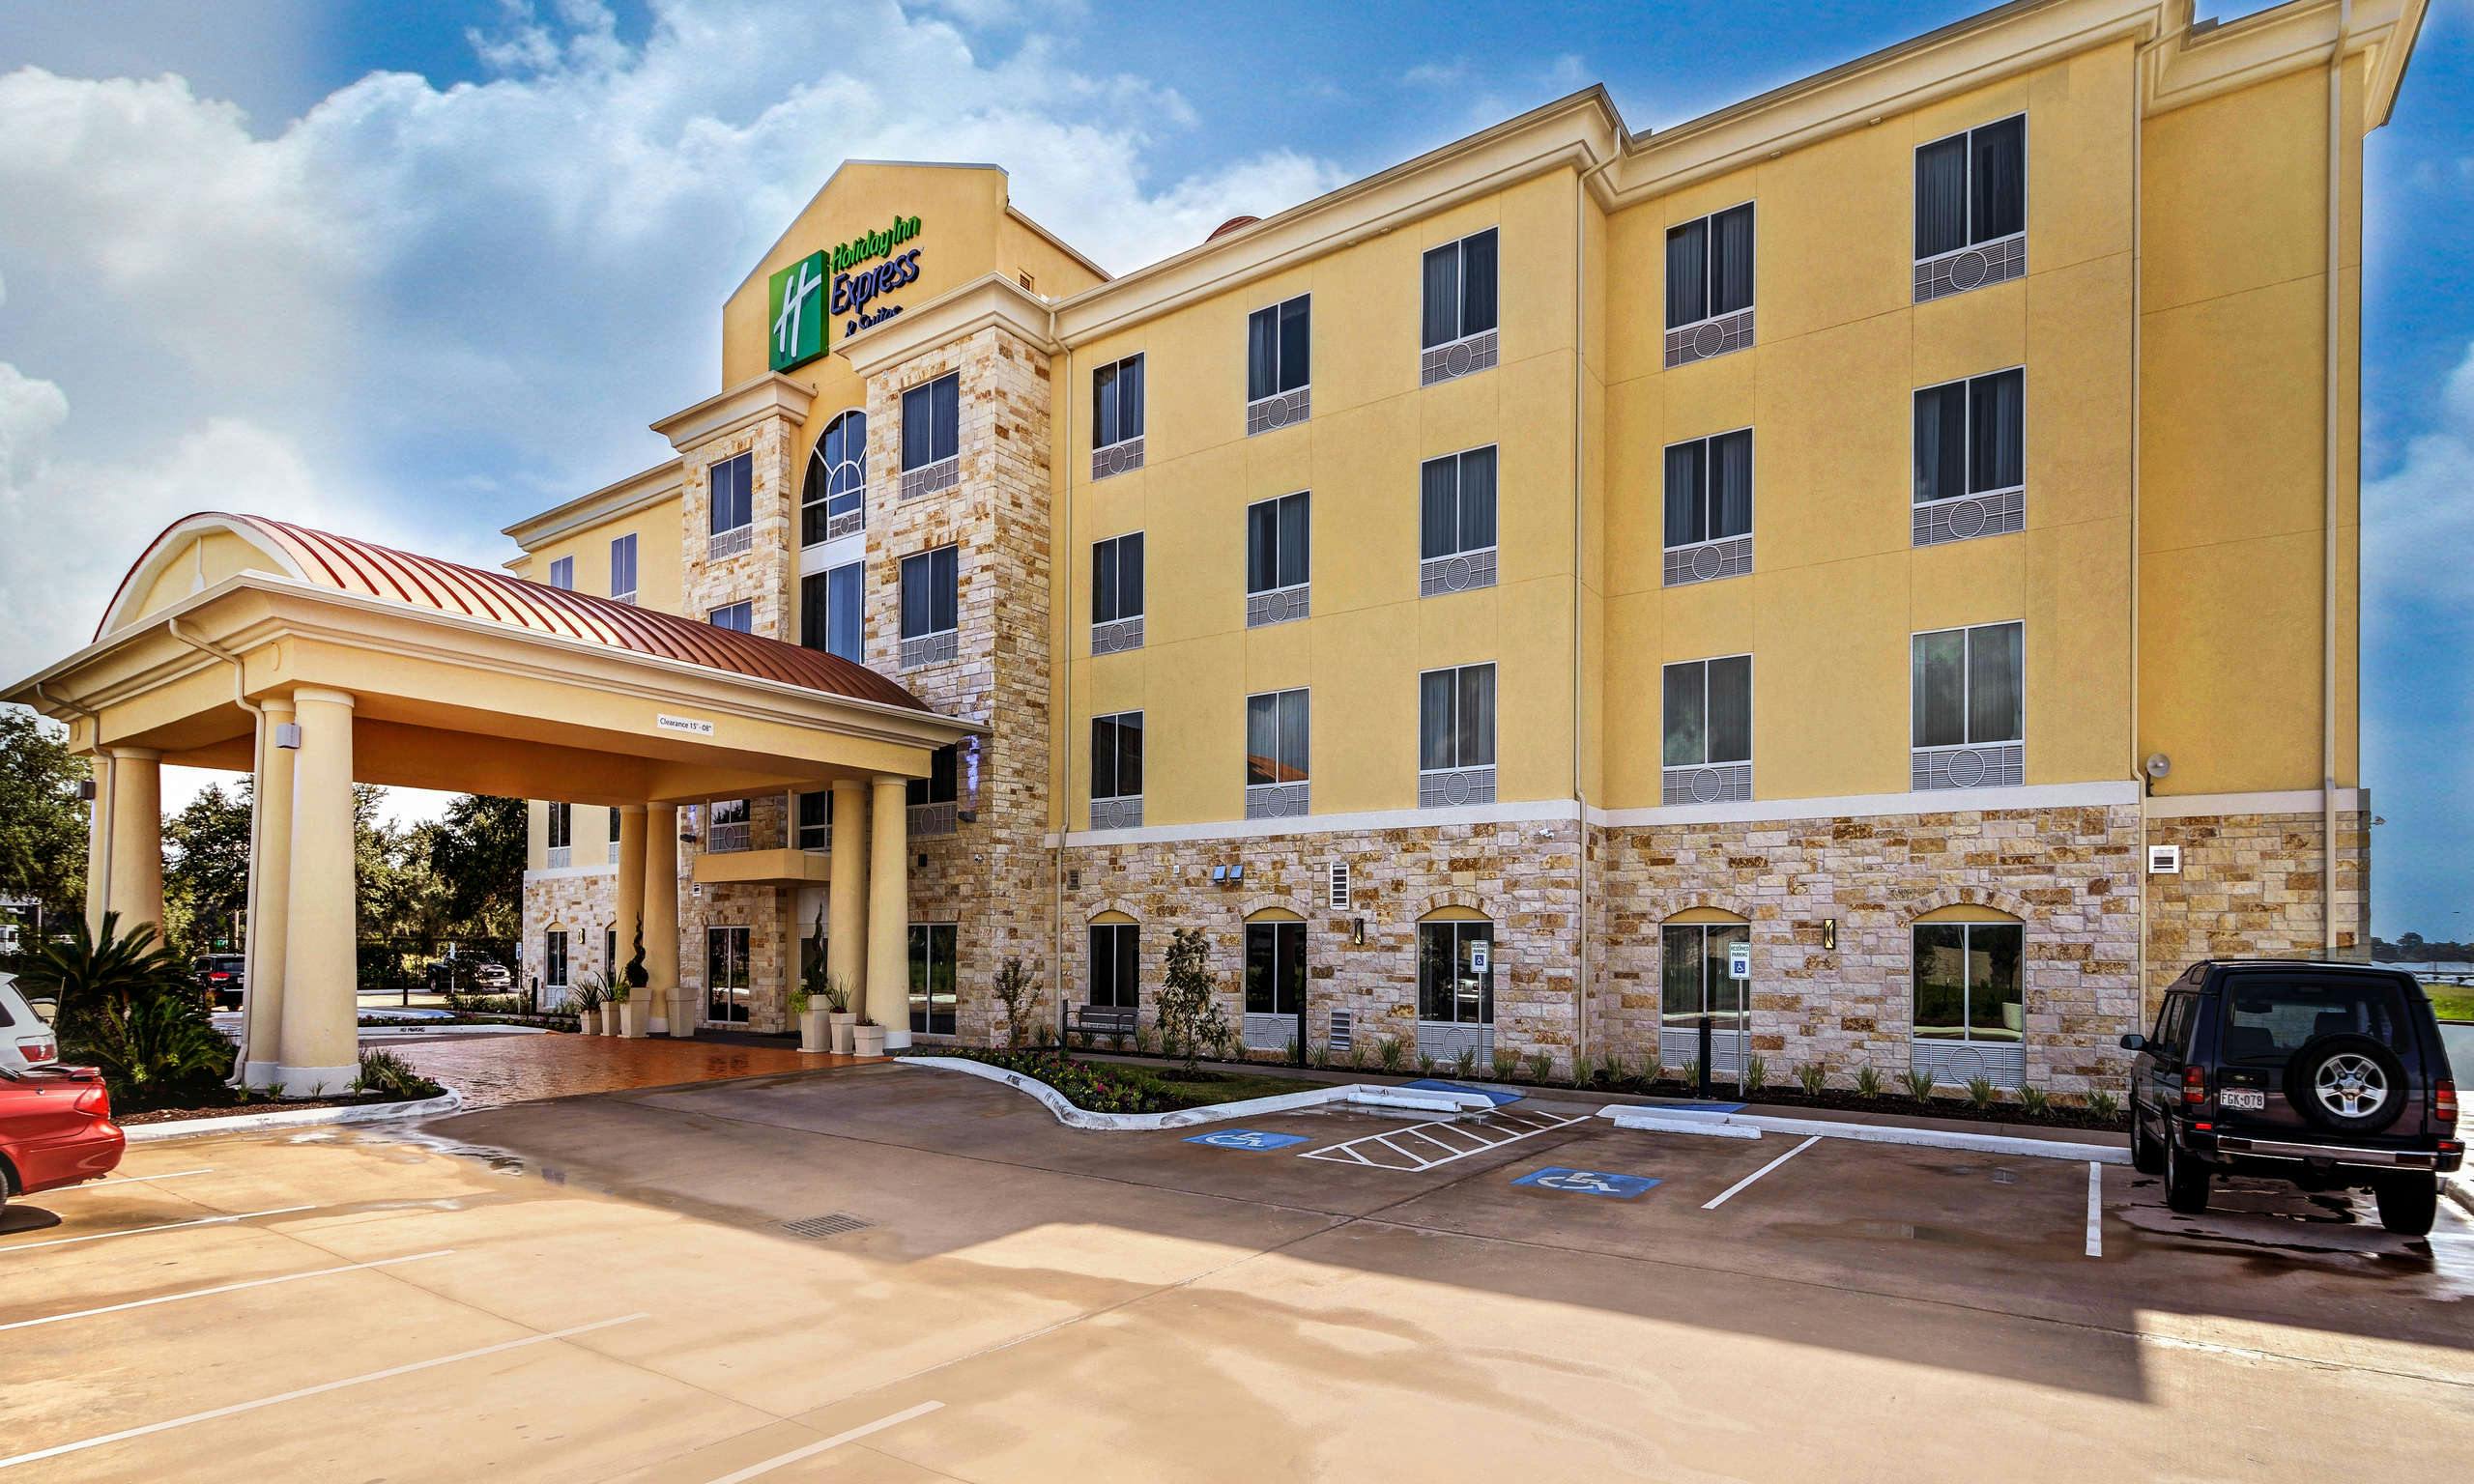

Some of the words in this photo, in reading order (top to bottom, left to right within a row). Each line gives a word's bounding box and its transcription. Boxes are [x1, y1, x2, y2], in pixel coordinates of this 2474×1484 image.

[831, 229, 893, 273] Holiday
[892, 215, 921, 244] Inn
[830, 248, 921, 316] Express
[659, 717, 689, 728] Clearance
